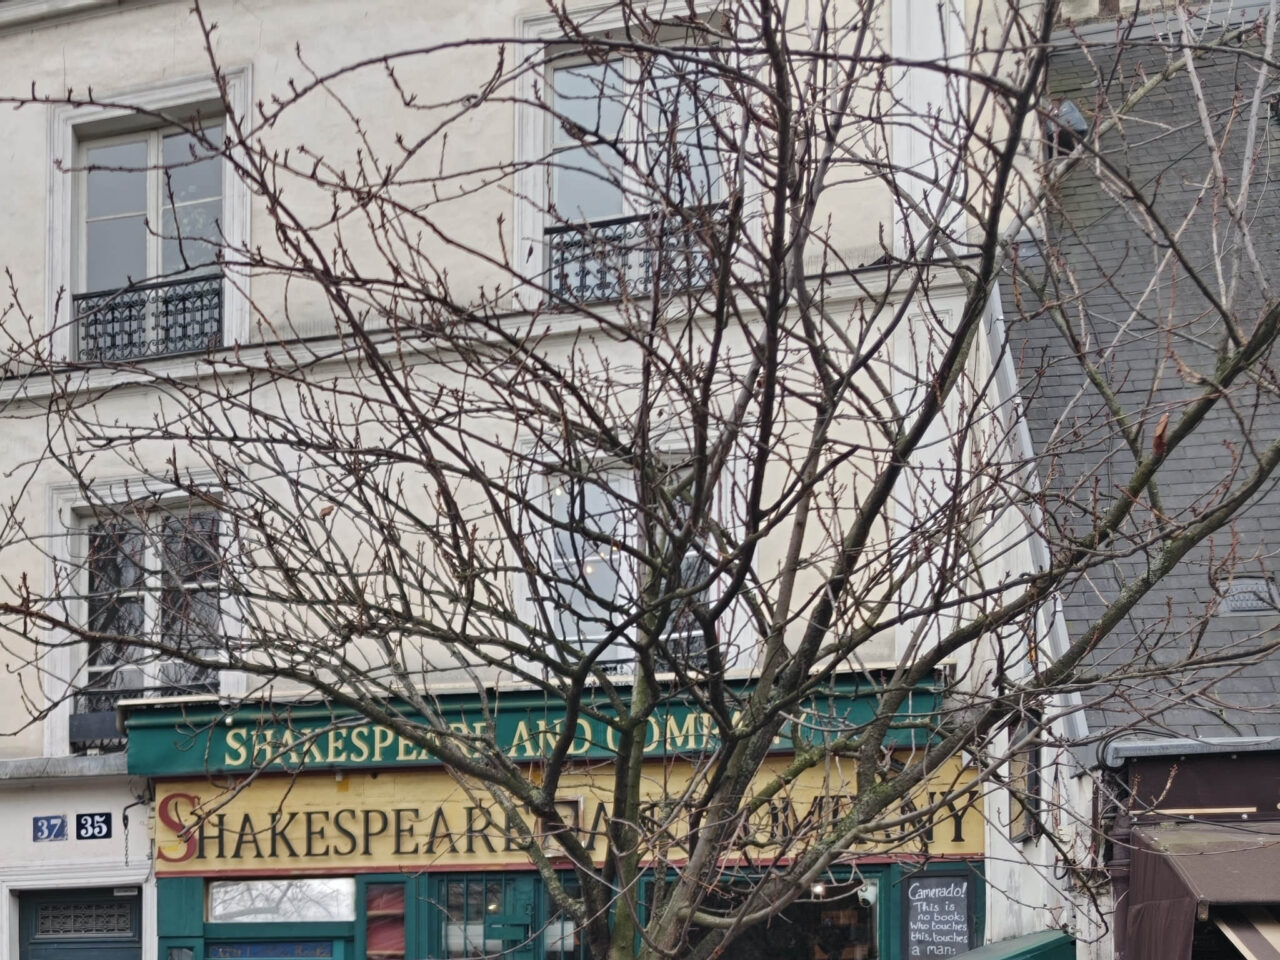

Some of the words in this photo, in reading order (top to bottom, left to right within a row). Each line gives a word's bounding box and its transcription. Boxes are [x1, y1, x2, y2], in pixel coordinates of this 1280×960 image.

[37, 818, 62, 840] 37
[80, 815, 108, 838] 35
[156, 793, 535, 863] SHAKESPEARE
[908, 882, 968, 900] Camerado!
[913, 902, 940, 912] This
[944, 901, 956, 911] is
[917, 913, 931, 921] no
[931, 921, 968, 931] touches
[932, 931, 969, 944] touches
[911, 945, 921, 956] a
